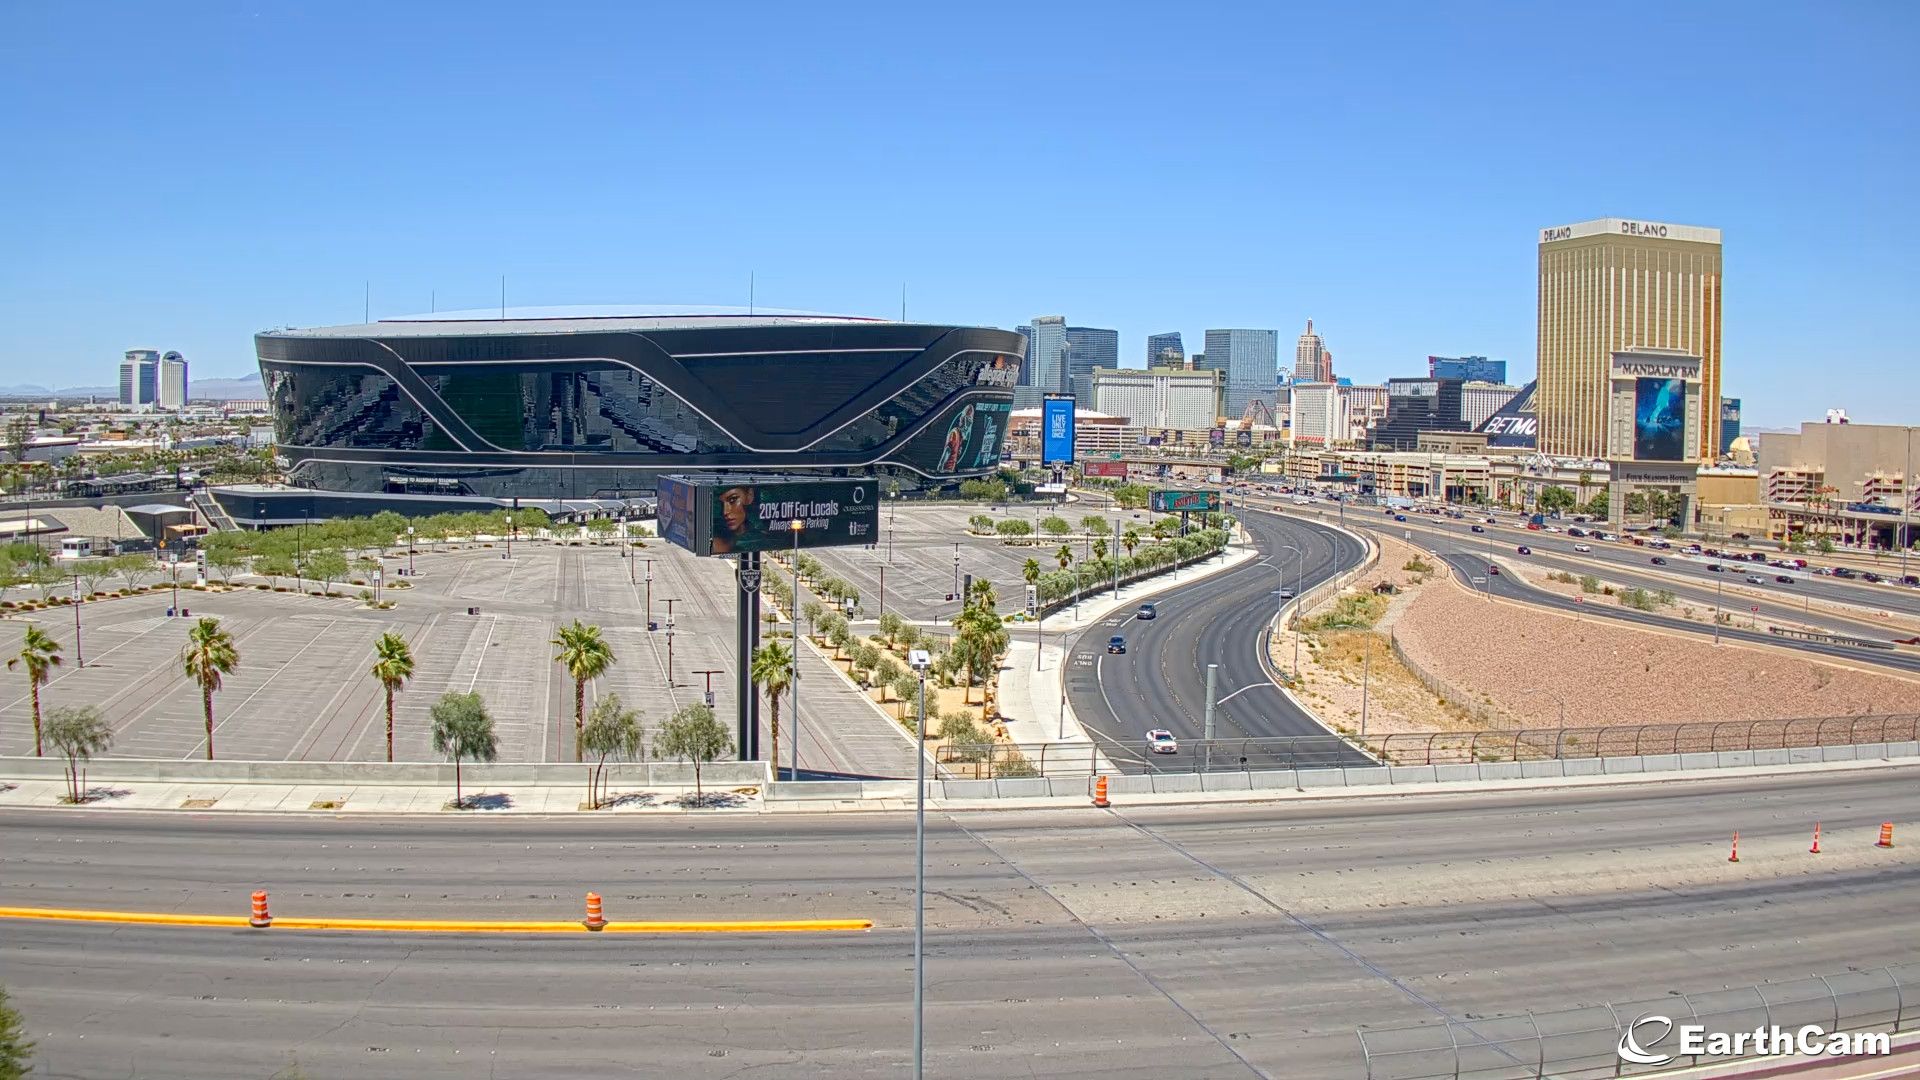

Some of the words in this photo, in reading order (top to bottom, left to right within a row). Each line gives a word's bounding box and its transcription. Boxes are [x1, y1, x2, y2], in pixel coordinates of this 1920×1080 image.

[1543, 227, 1572, 242] DELANO
[1620, 221, 1668, 238] DELANO
[1622, 363, 1679, 378] MANDALAY
[1681, 366, 1699, 379] BAY
[760, 502, 780, 519] 20%
[781, 501, 795, 518] Off
[795, 501, 810, 517] For
[811, 500, 838, 516] Locals
[769, 519, 791, 532] Always
[806, 518, 829, 530] Parking
